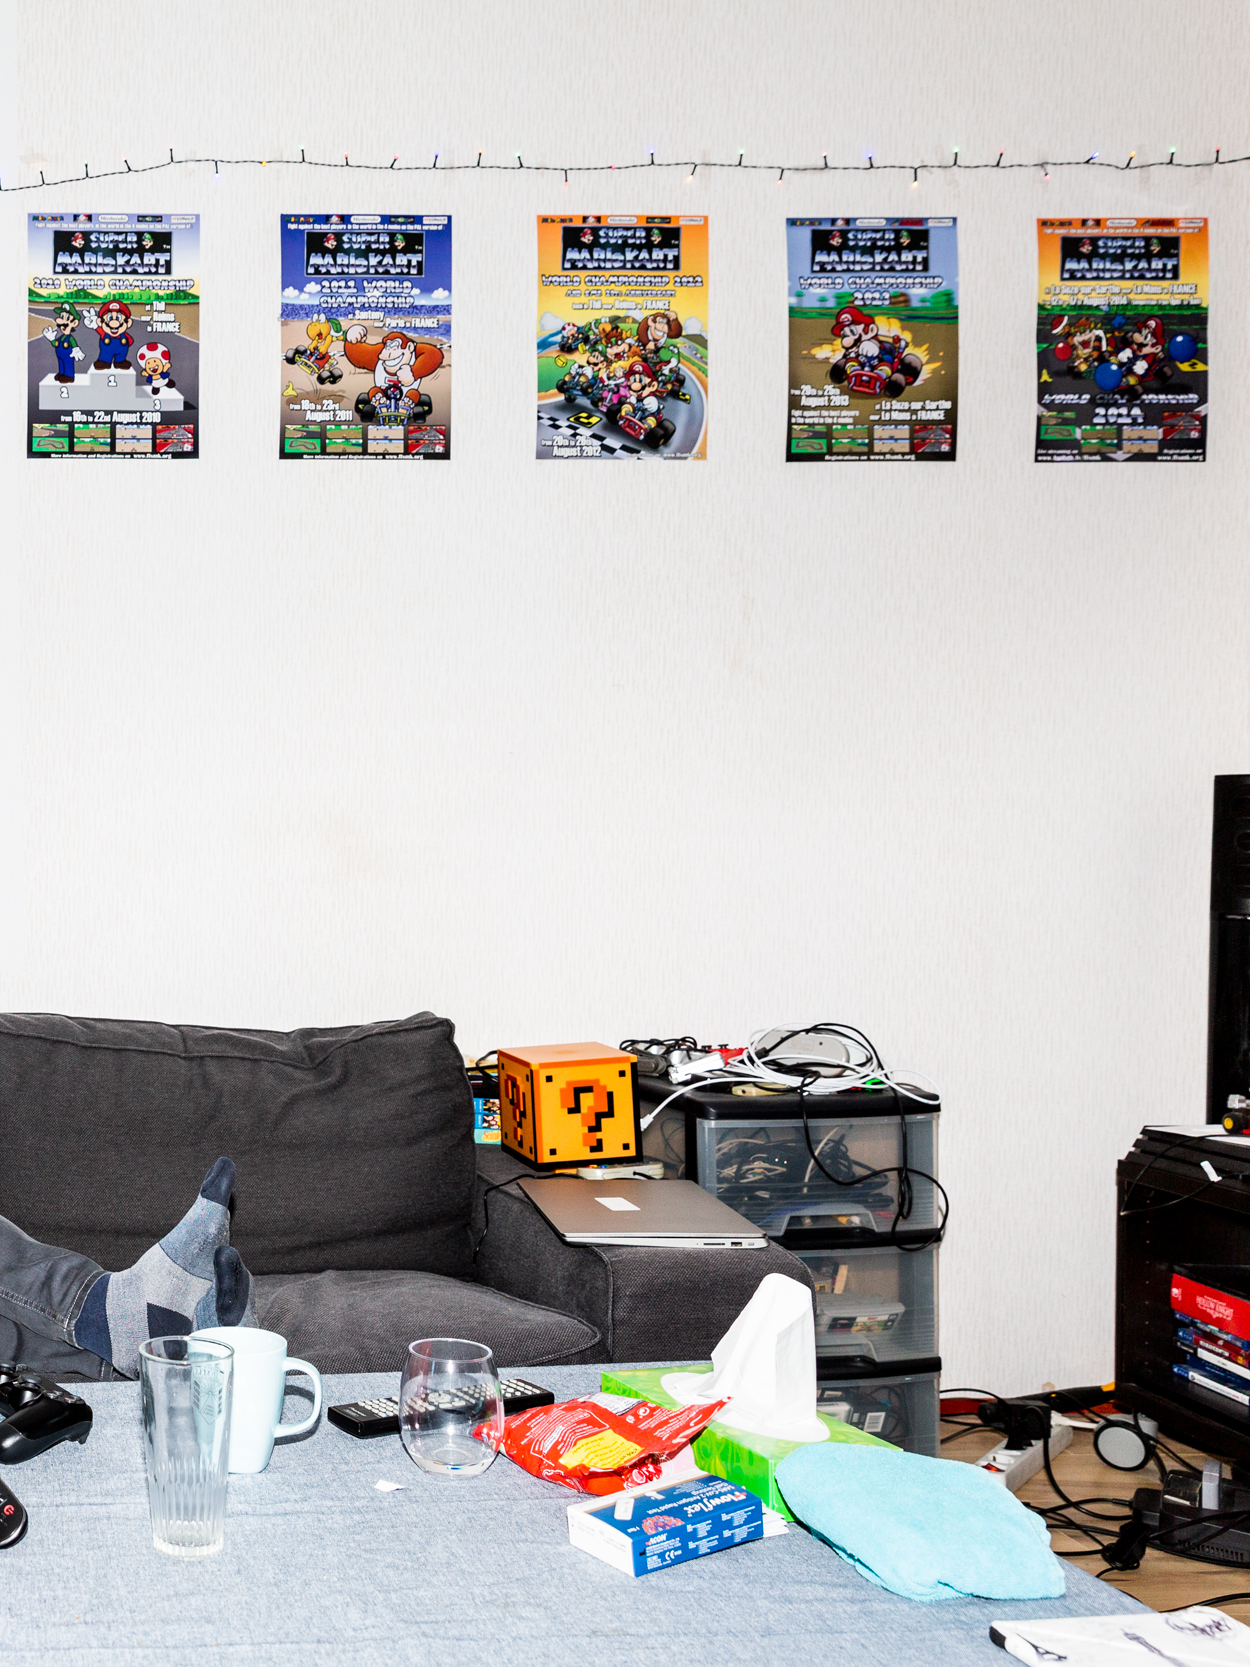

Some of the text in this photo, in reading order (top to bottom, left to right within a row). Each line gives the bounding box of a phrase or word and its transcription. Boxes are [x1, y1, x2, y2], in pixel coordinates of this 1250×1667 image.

[89, 232, 138, 249] SUPER
[342, 233, 390, 250] SUPER
[598, 228, 646, 244] SUPER
[847, 230, 895, 246] SUPER
[1097, 238, 1145, 254] SUPER
[33, 277, 195, 291] 2010 WORLD CHAMPIONSHIP
[320, 279, 413, 294] 2011 WORLD
[541, 274, 704, 287] WORLD CHAMPIONSHIP 2012
[799, 276, 943, 289] WORLD CHAMPIONSHIP
[624, 289, 676, 297] ANNIVERSARY
[1143, 284, 1162, 294] Mans
[1169, 284, 1198, 294] FRANCE
[319, 295, 415, 308] CHAMPIONSHIP
[853, 290, 891, 306] 2013
[1083, 296, 1109, 306] August
[642, 300, 670, 310] FRANCE
[152, 322, 181, 333] FRANCE
[385, 318, 405, 327] Paris
[411, 318, 439, 328] FRANCE
[107, 375, 118, 387] 1
[59, 386, 69, 399] 2
[1041, 394, 1091, 404] WORLD
[153, 399, 161, 410] 3
[301, 399, 315, 410] 18th
[322, 399, 340, 410] 23rd
[800, 395, 849, 408] August 2013
[882, 401, 891, 410] La
[73, 411, 87, 422] 16th
[94, 411, 111, 422] 22nd
[112, 411, 141, 424] August
[142, 412, 161, 422] 2010
[305, 410, 353, 423] August 2011
[881, 411, 890, 420] Le
[891, 411, 911, 420] Mans
[917, 411, 946, 420] FRANCE
[1092, 406, 1145, 424] 2014
[552, 446, 602, 458] August 2012
[684, 1492, 747, 1516] Flowflex
